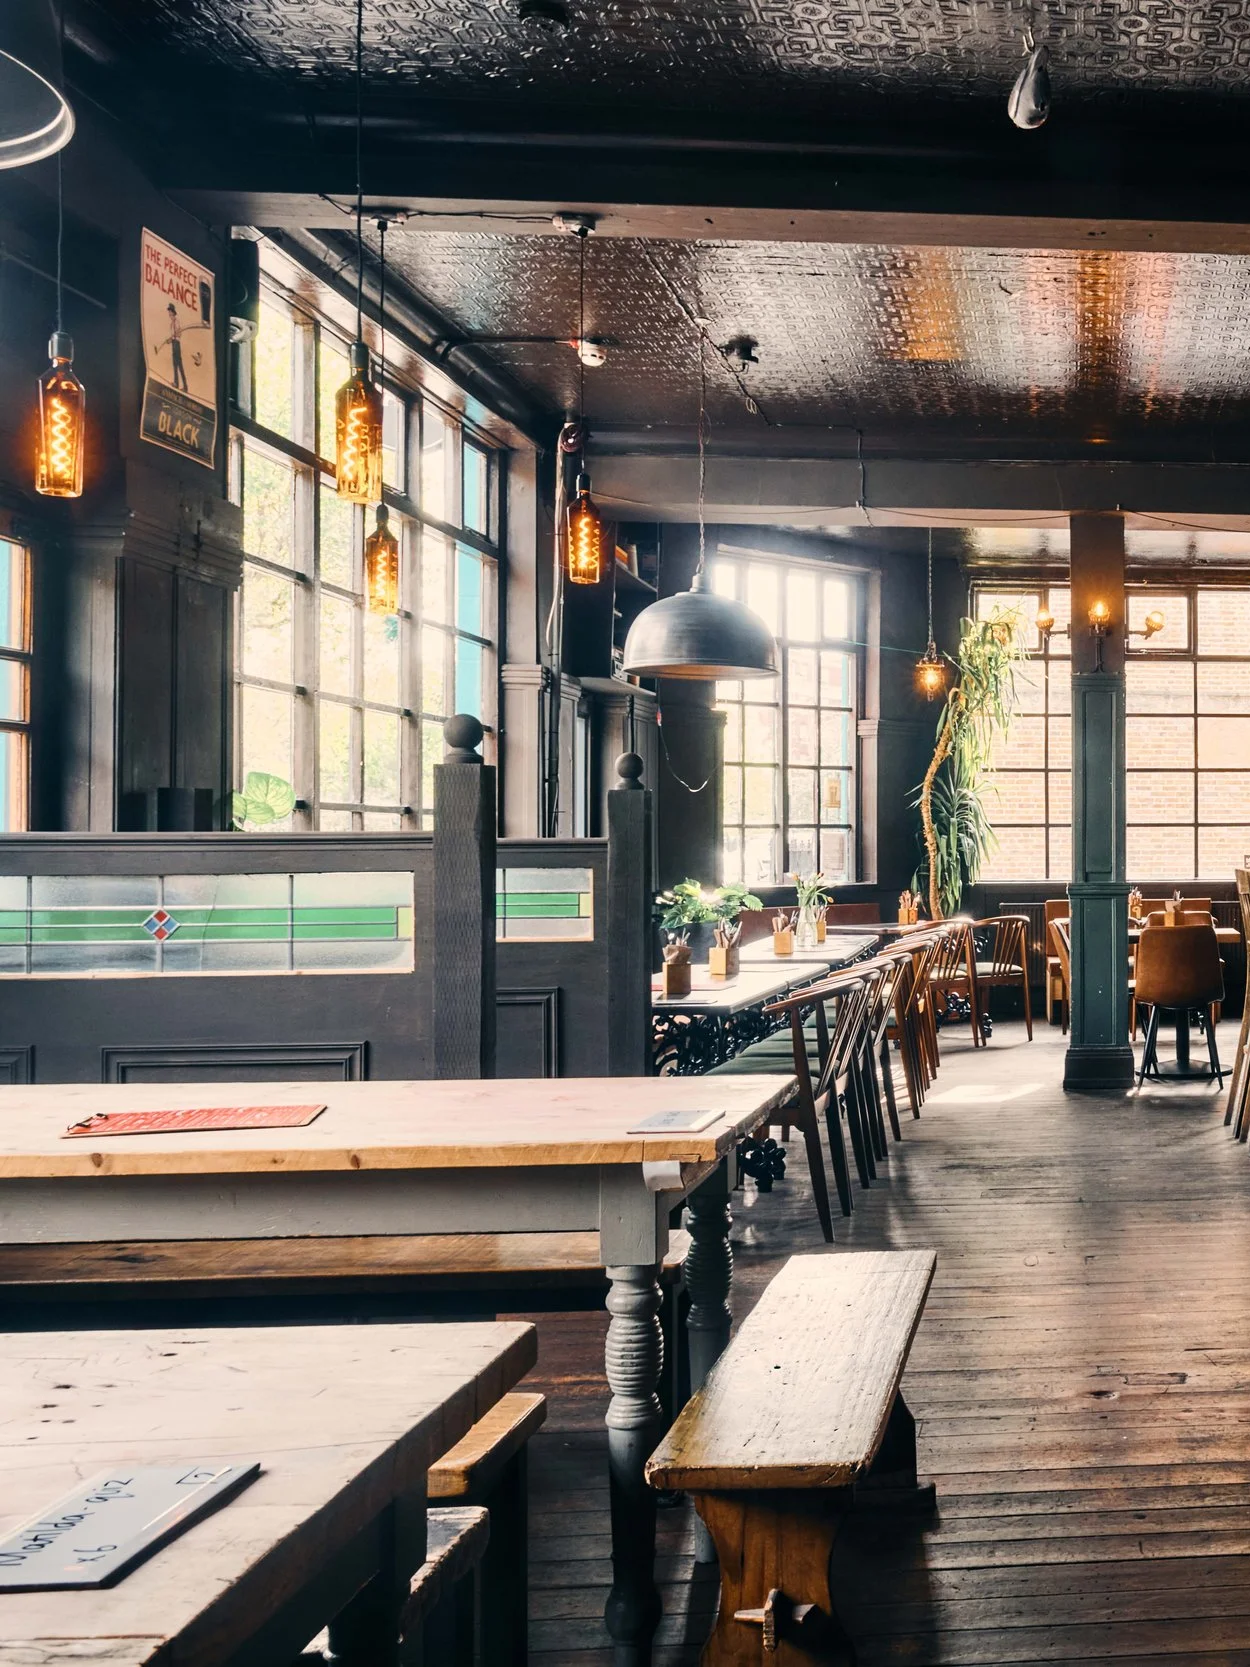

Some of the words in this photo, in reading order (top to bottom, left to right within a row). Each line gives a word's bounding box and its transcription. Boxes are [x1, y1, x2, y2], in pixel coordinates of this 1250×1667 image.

[144, 263, 198, 312] BALANCE
[145, 243, 162, 267] THE
[164, 255, 198, 289] PERFECT
[158, 411, 200, 449] BLACK
